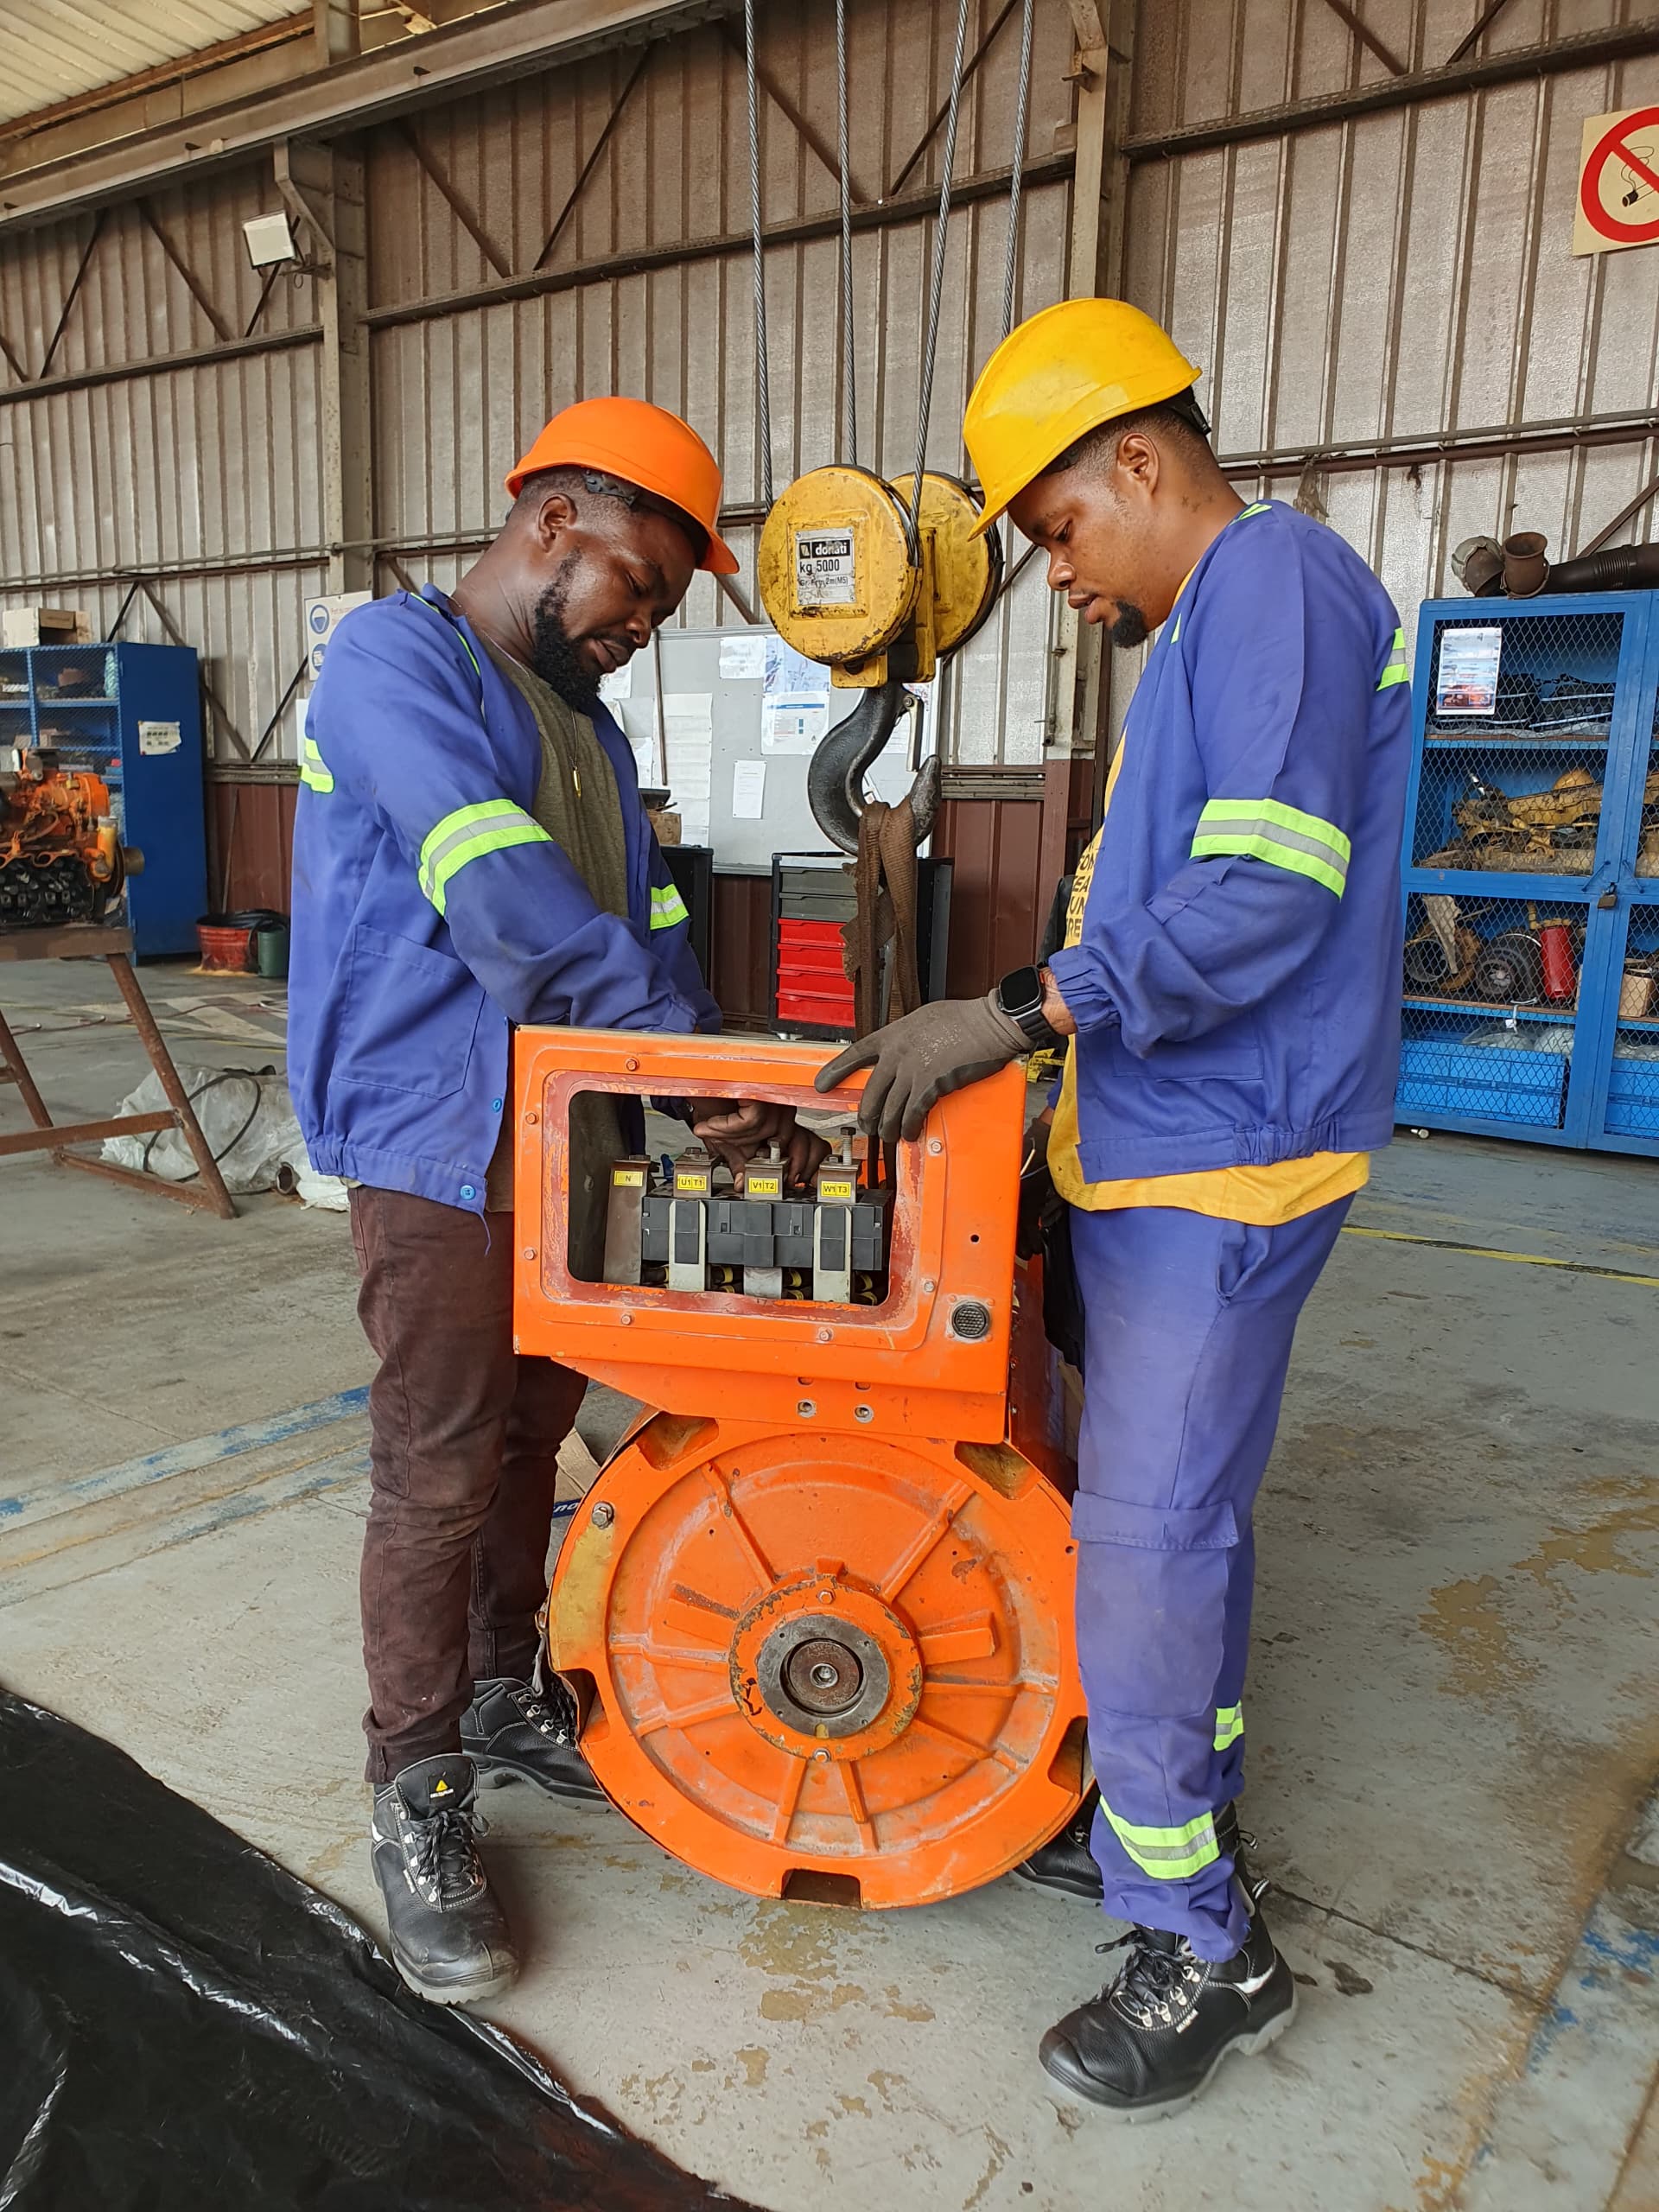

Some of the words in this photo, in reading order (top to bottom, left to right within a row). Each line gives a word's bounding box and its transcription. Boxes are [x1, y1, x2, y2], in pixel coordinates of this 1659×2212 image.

[815, 543, 847, 556] donati
[800, 562, 812, 575] kg
[816, 559, 840, 572] 5000
[681, 1178, 691, 1186] U1
[694, 1179, 703, 1187] T1
